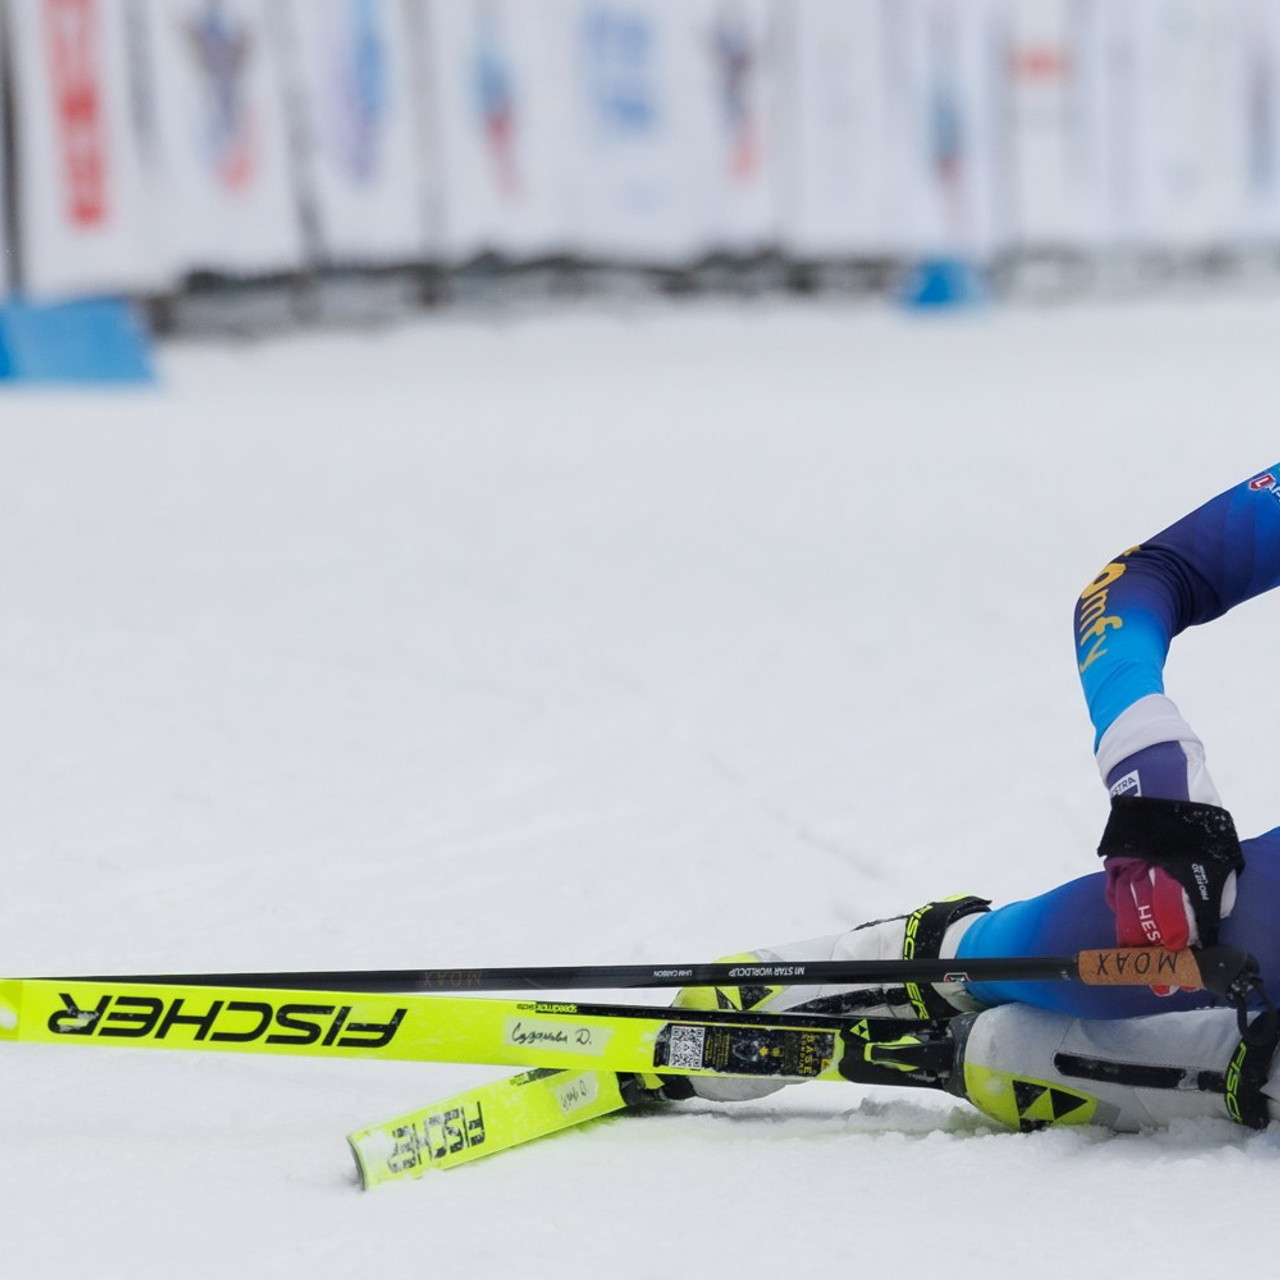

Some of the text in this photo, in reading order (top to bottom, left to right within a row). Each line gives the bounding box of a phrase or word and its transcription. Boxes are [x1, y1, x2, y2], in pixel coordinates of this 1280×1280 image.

[1137, 904, 1161, 947] HES
[653, 969, 678, 977] CARBON
[728, 966, 773, 977] WORLDCUP
[773, 967, 794, 976] STAR
[904, 905, 934, 1020] FISCER
[1096, 951, 1179, 977] MOAX
[48, 992, 408, 1048] FISCHER
